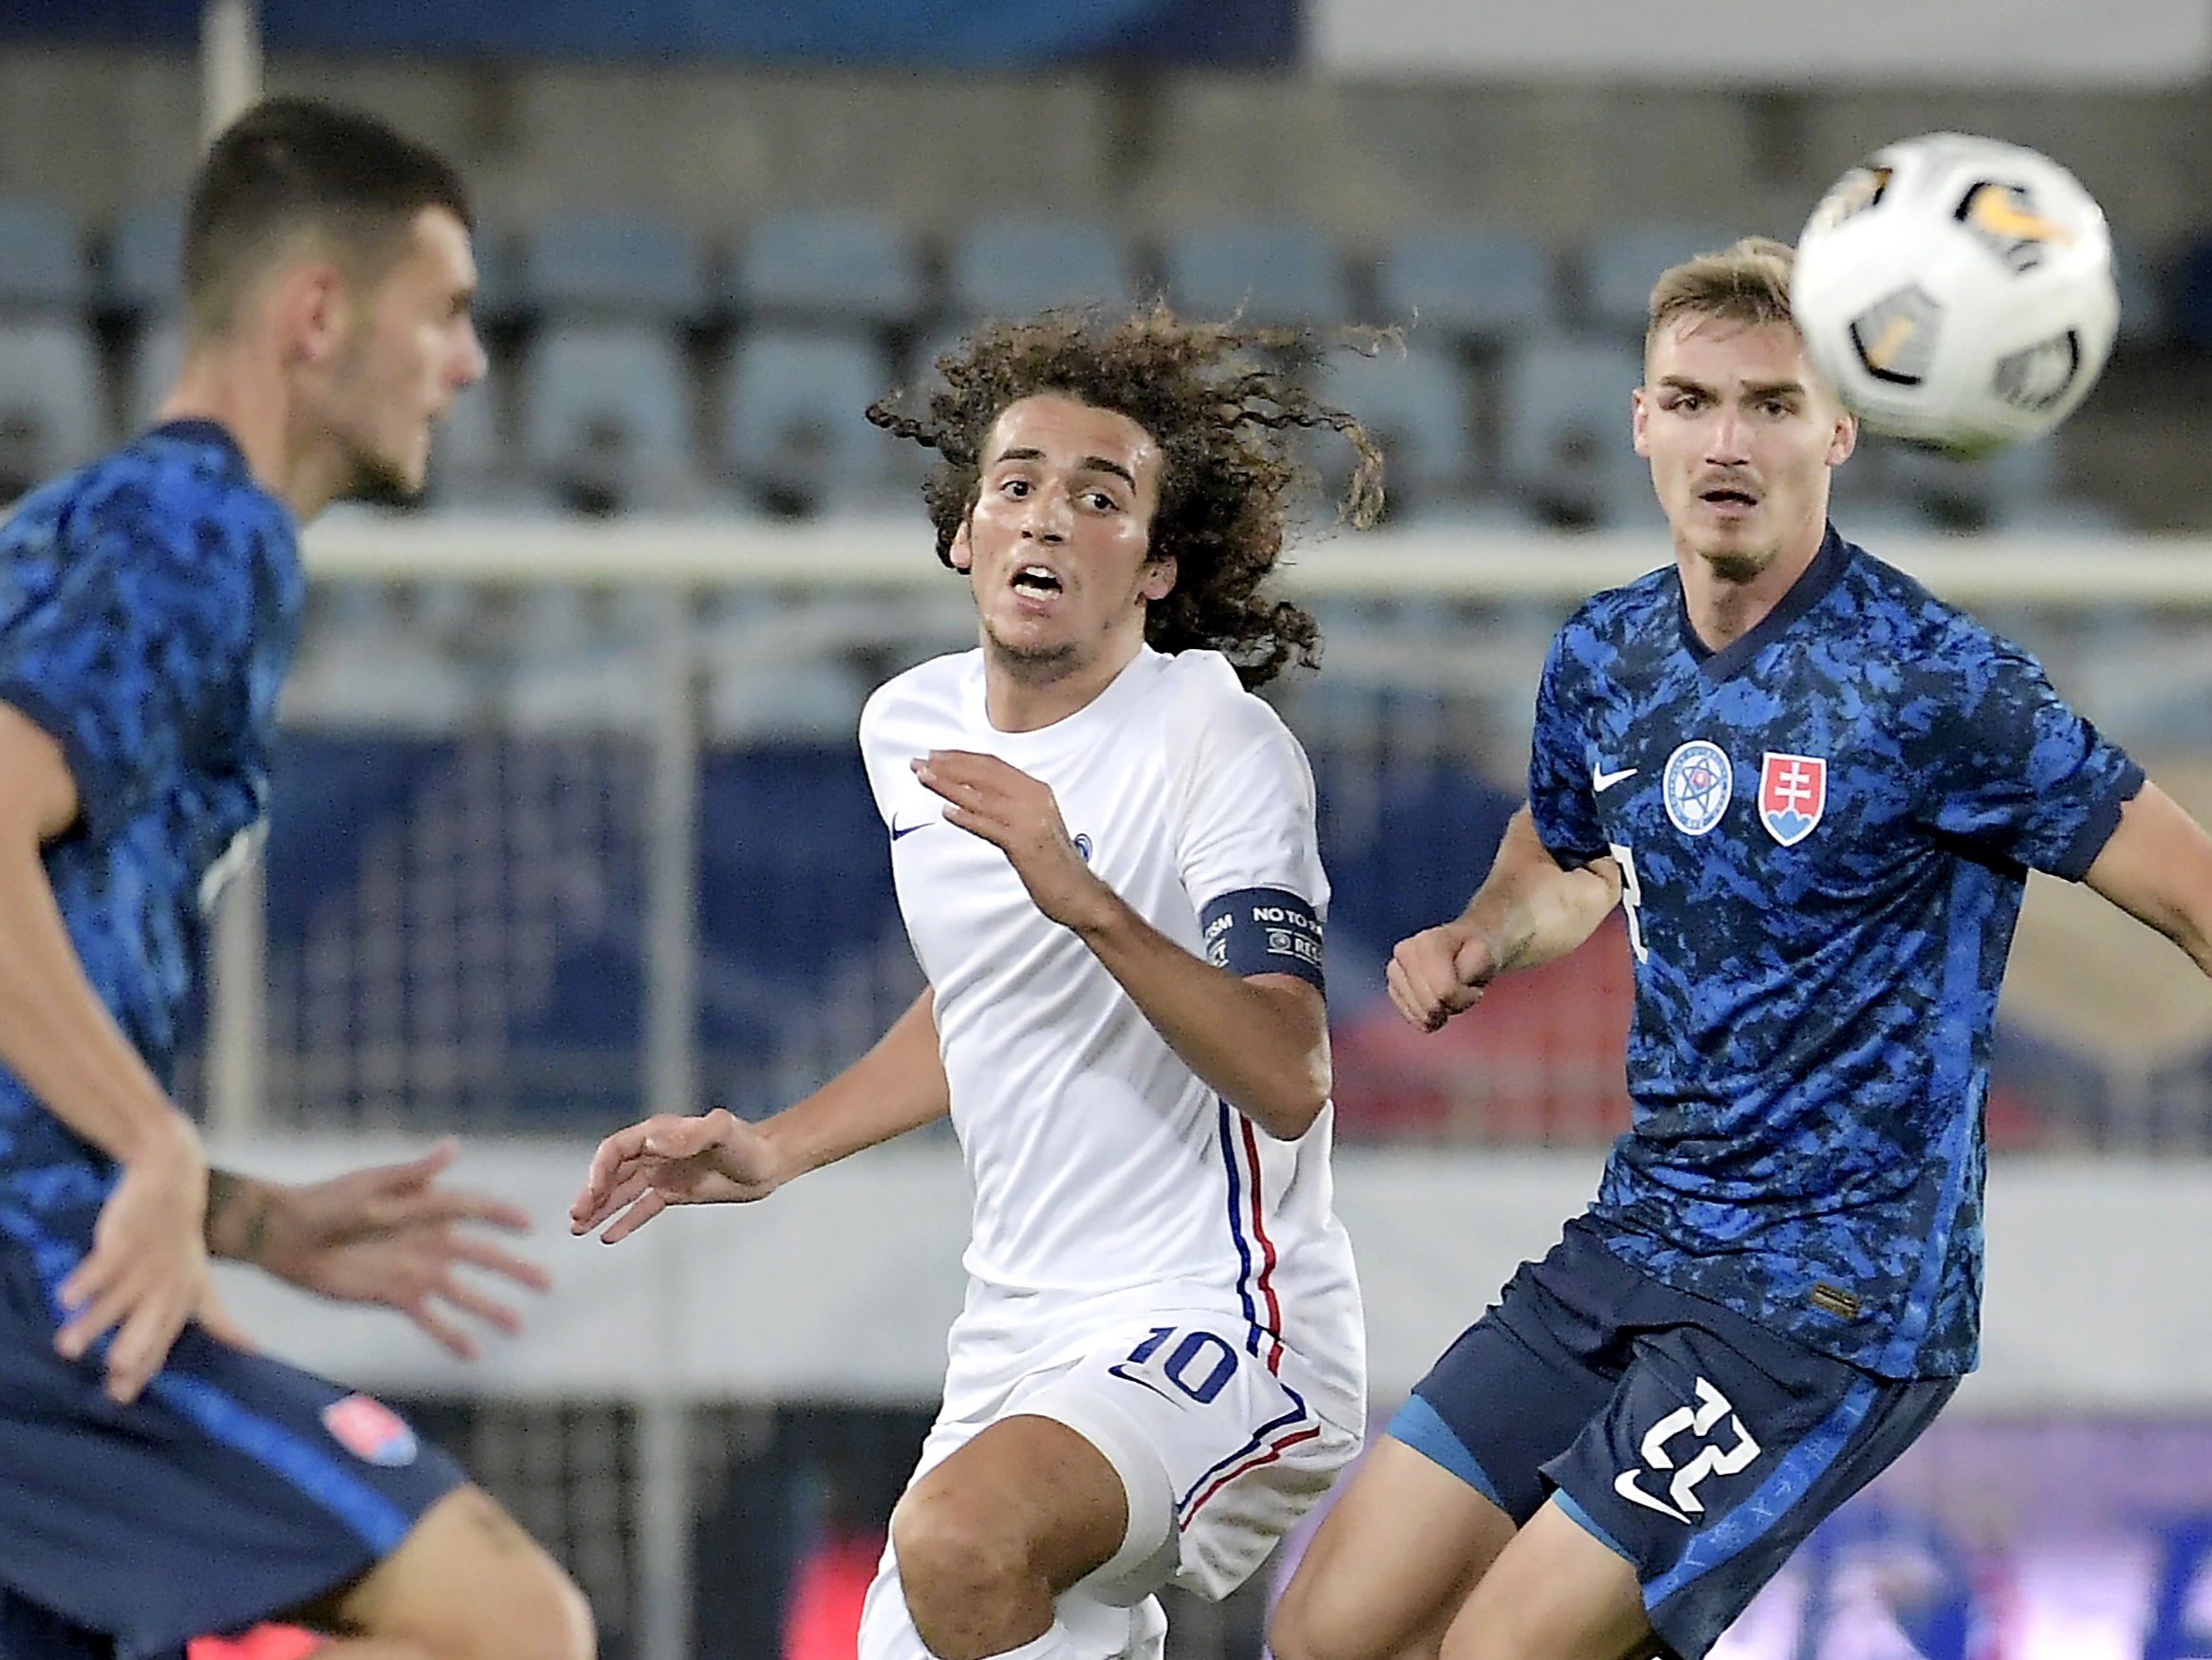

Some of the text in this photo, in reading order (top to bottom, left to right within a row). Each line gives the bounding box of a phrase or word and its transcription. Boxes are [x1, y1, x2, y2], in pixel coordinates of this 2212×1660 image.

[1253, 906, 1284, 922] NO
[1285, 909, 1308, 927] TO
[1126, 1326, 1239, 1405] 10
